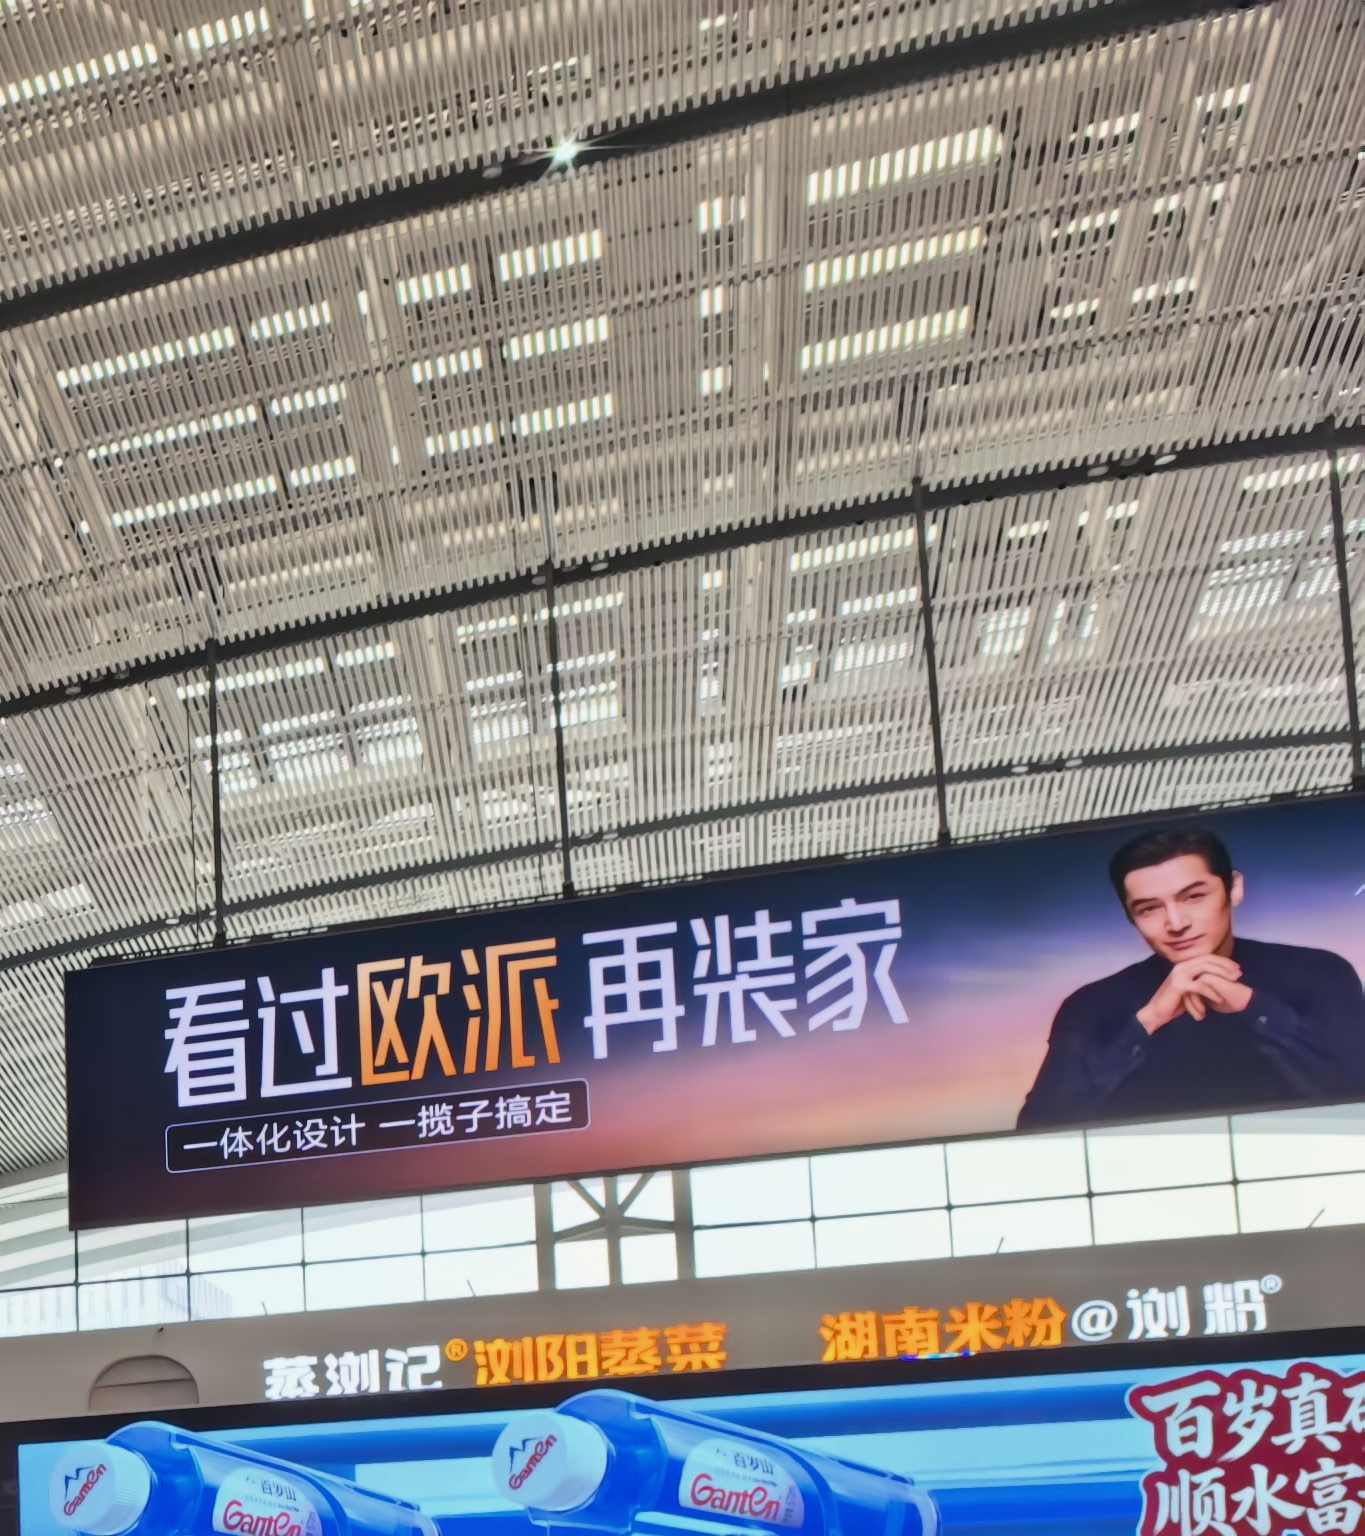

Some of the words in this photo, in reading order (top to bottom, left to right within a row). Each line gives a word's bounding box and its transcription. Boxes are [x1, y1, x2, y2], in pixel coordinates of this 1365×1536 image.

[164, 938, 560, 1107] 看过欧派
[582, 898, 909, 1059] 再装家
[183, 1114, 366, 1159] 一体化设计
[379, 1091, 573, 1138] 一揽子搞定
[1141, 1372, 1365, 1463] 百岁真
